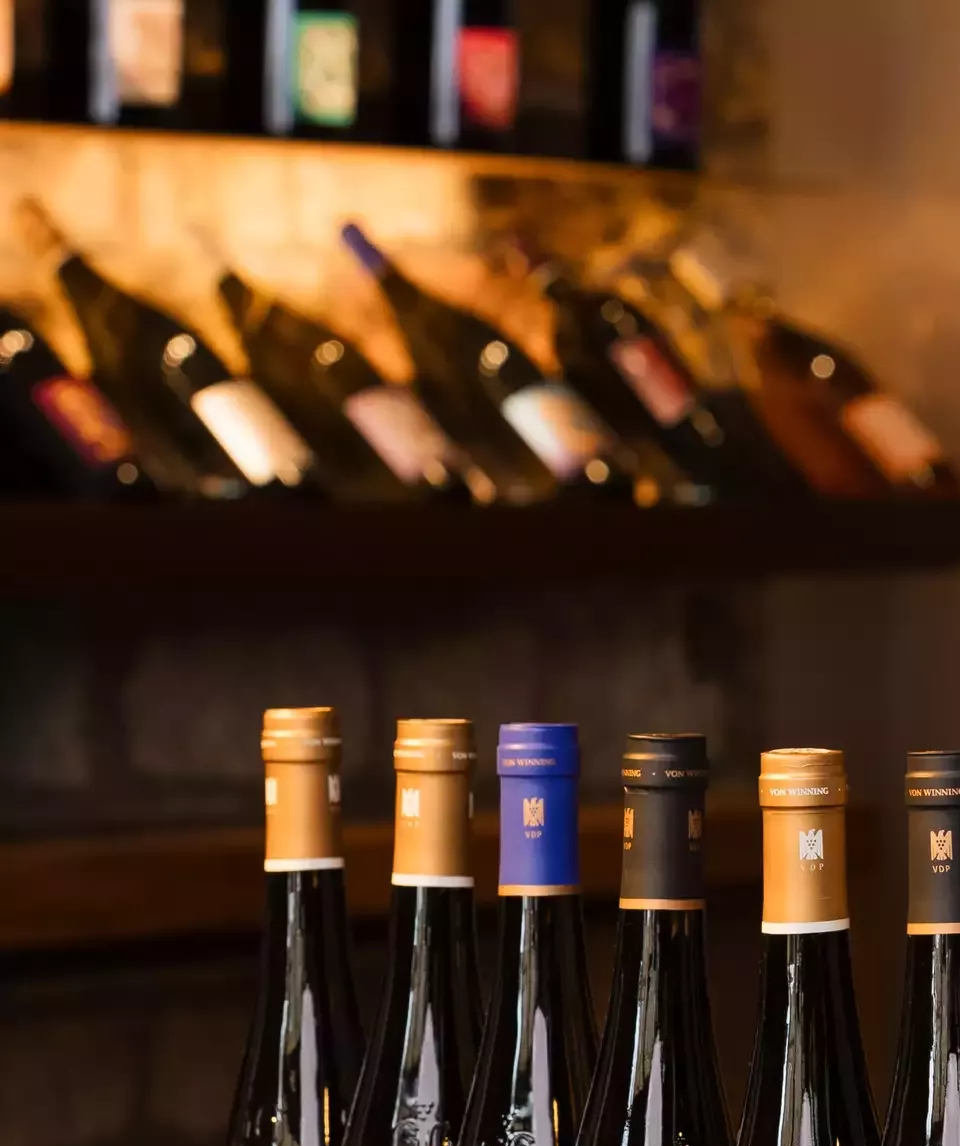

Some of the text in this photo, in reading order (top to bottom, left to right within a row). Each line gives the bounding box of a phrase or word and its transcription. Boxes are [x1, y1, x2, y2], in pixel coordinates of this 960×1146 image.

[664, 770, 685, 778] VON
[769, 787, 829, 796] VON WINNING
[524, 830, 542, 839] VDP
[932, 865, 950, 873] VDP
